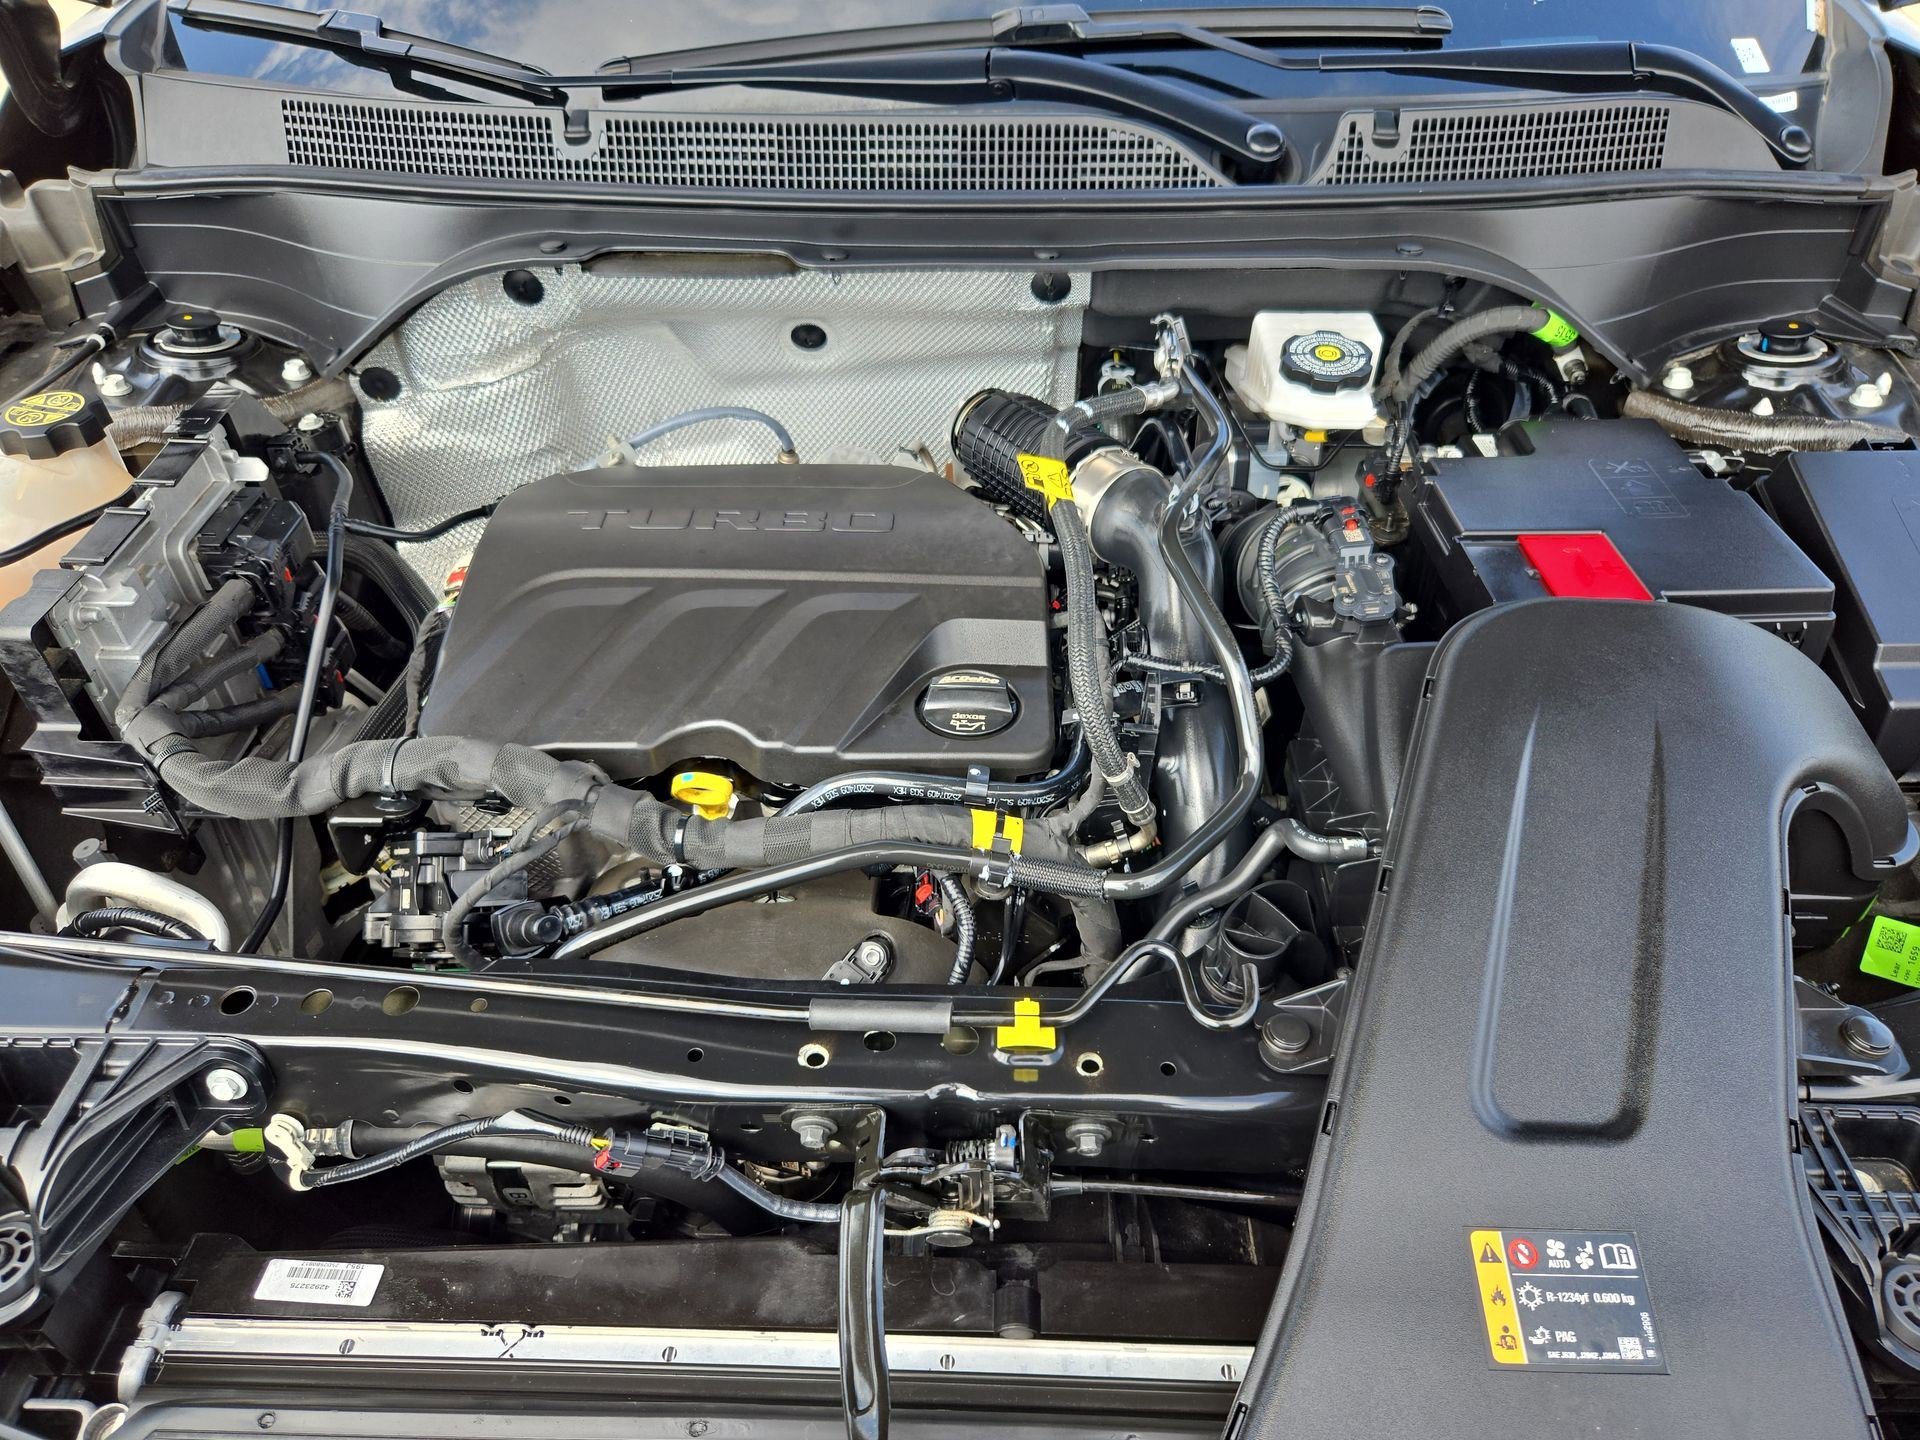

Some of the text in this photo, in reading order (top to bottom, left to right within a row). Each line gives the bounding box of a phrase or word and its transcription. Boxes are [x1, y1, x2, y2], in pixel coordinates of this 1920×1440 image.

[567, 510, 896, 532] TURBO
[1907, 945, 1920, 966] 1659
[1890, 962, 1901, 978] Lear
[1548, 1259, 1571, 1269] AUTO
[1545, 1291, 1636, 1306] R-1234yf 0.600 kg
[1555, 1331, 1577, 1343] PAG
